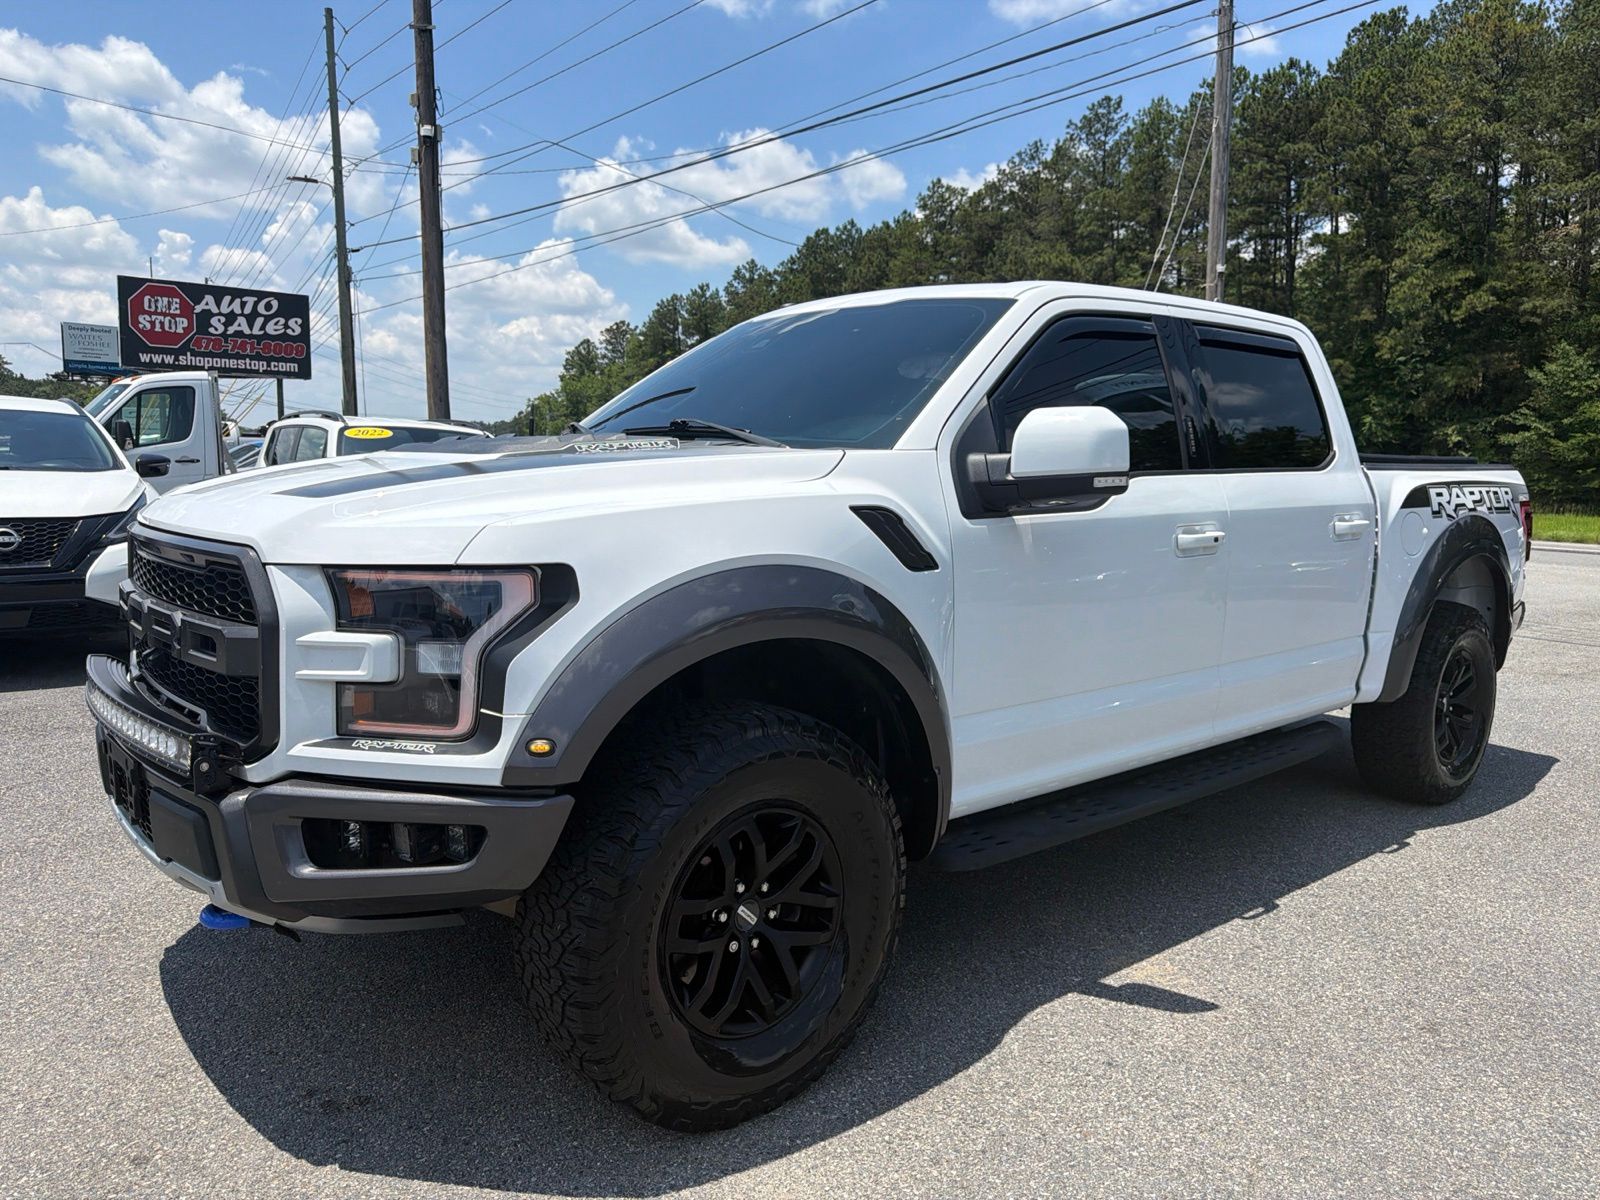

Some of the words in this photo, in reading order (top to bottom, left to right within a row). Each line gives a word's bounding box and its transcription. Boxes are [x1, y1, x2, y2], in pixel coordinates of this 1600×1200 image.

[143, 295, 181, 314] ONE
[194, 294, 279, 315] AUTO
[68, 325, 89, 333] Deeply
[90, 326, 112, 334] Rooted
[138, 314, 189, 334] STOP
[139, 352, 299, 373] www.shoponestop.com
[1427, 485, 1520, 519] RAPTOR
[352, 739, 437, 754] RAPTOR
